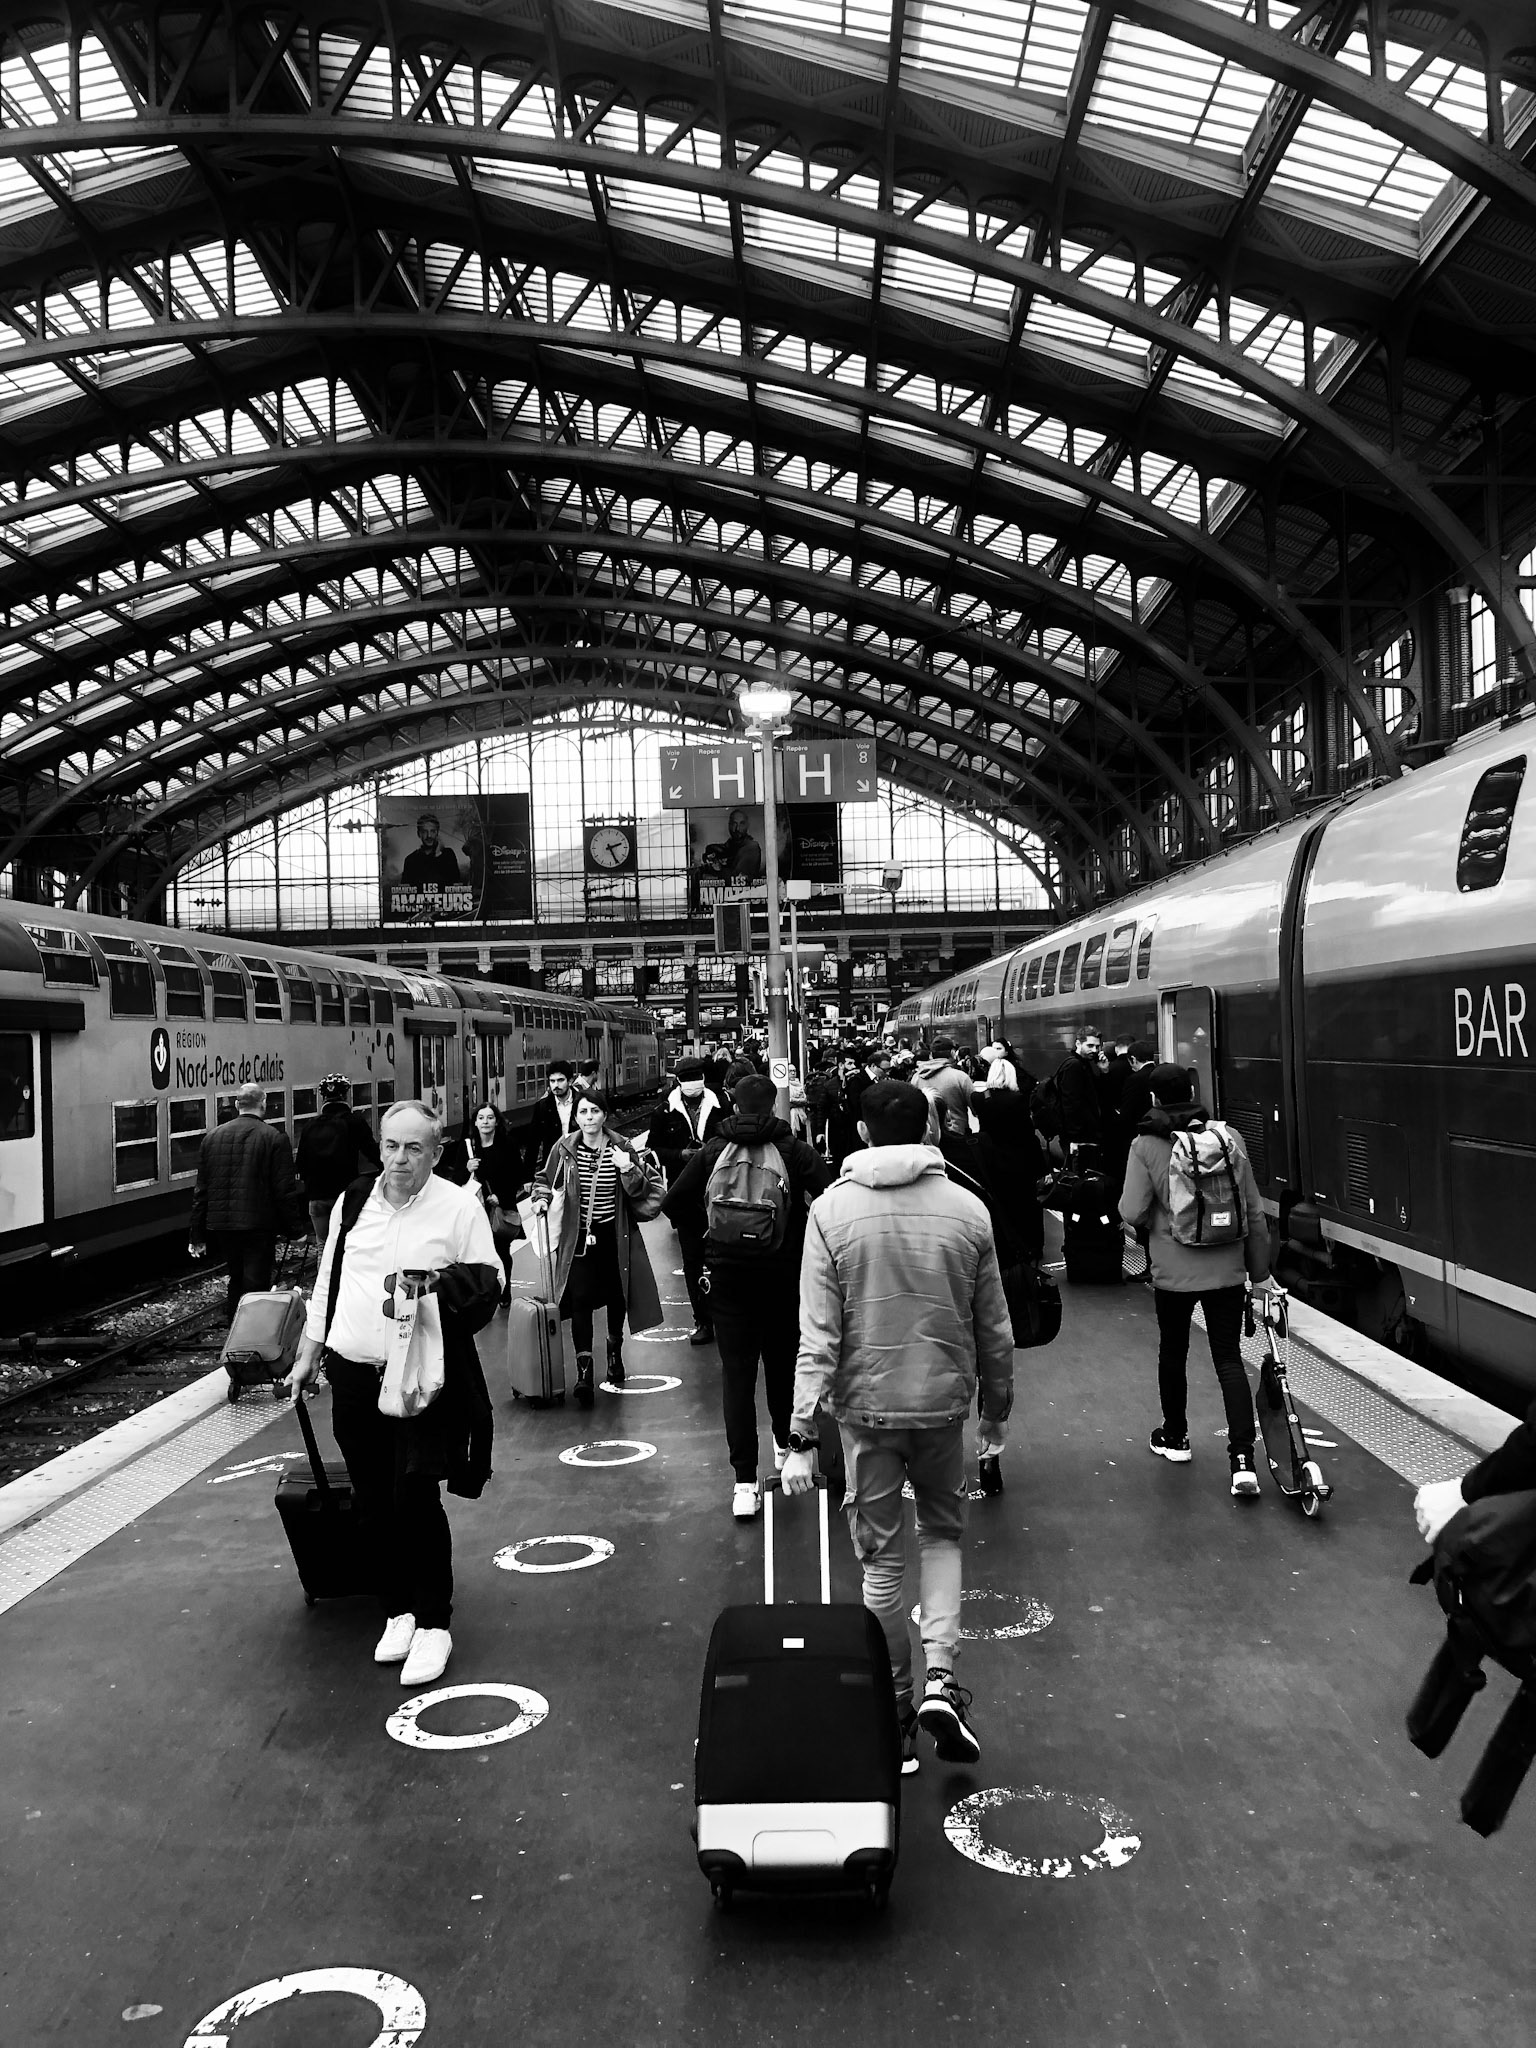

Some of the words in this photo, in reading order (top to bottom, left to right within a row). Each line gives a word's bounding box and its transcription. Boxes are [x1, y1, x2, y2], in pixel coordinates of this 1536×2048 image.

[698, 748, 721, 756] Repère
[786, 745, 809, 753] Repère
[669, 758, 678, 771] 7
[858, 751, 868, 764] 8
[711, 756, 745, 800] H
[799, 753, 832, 796] H
[422, 883, 439, 894] LES
[731, 876, 747, 886] LES
[391, 893, 473, 913] AMATEURS
[1454, 983, 1529, 1058] BAR
[176, 1028, 207, 1049] RÉGION
[176, 1054, 236, 1089] Nord-Pas
[239, 1053, 251, 1084] de
[253, 1052, 284, 1083] Calais
